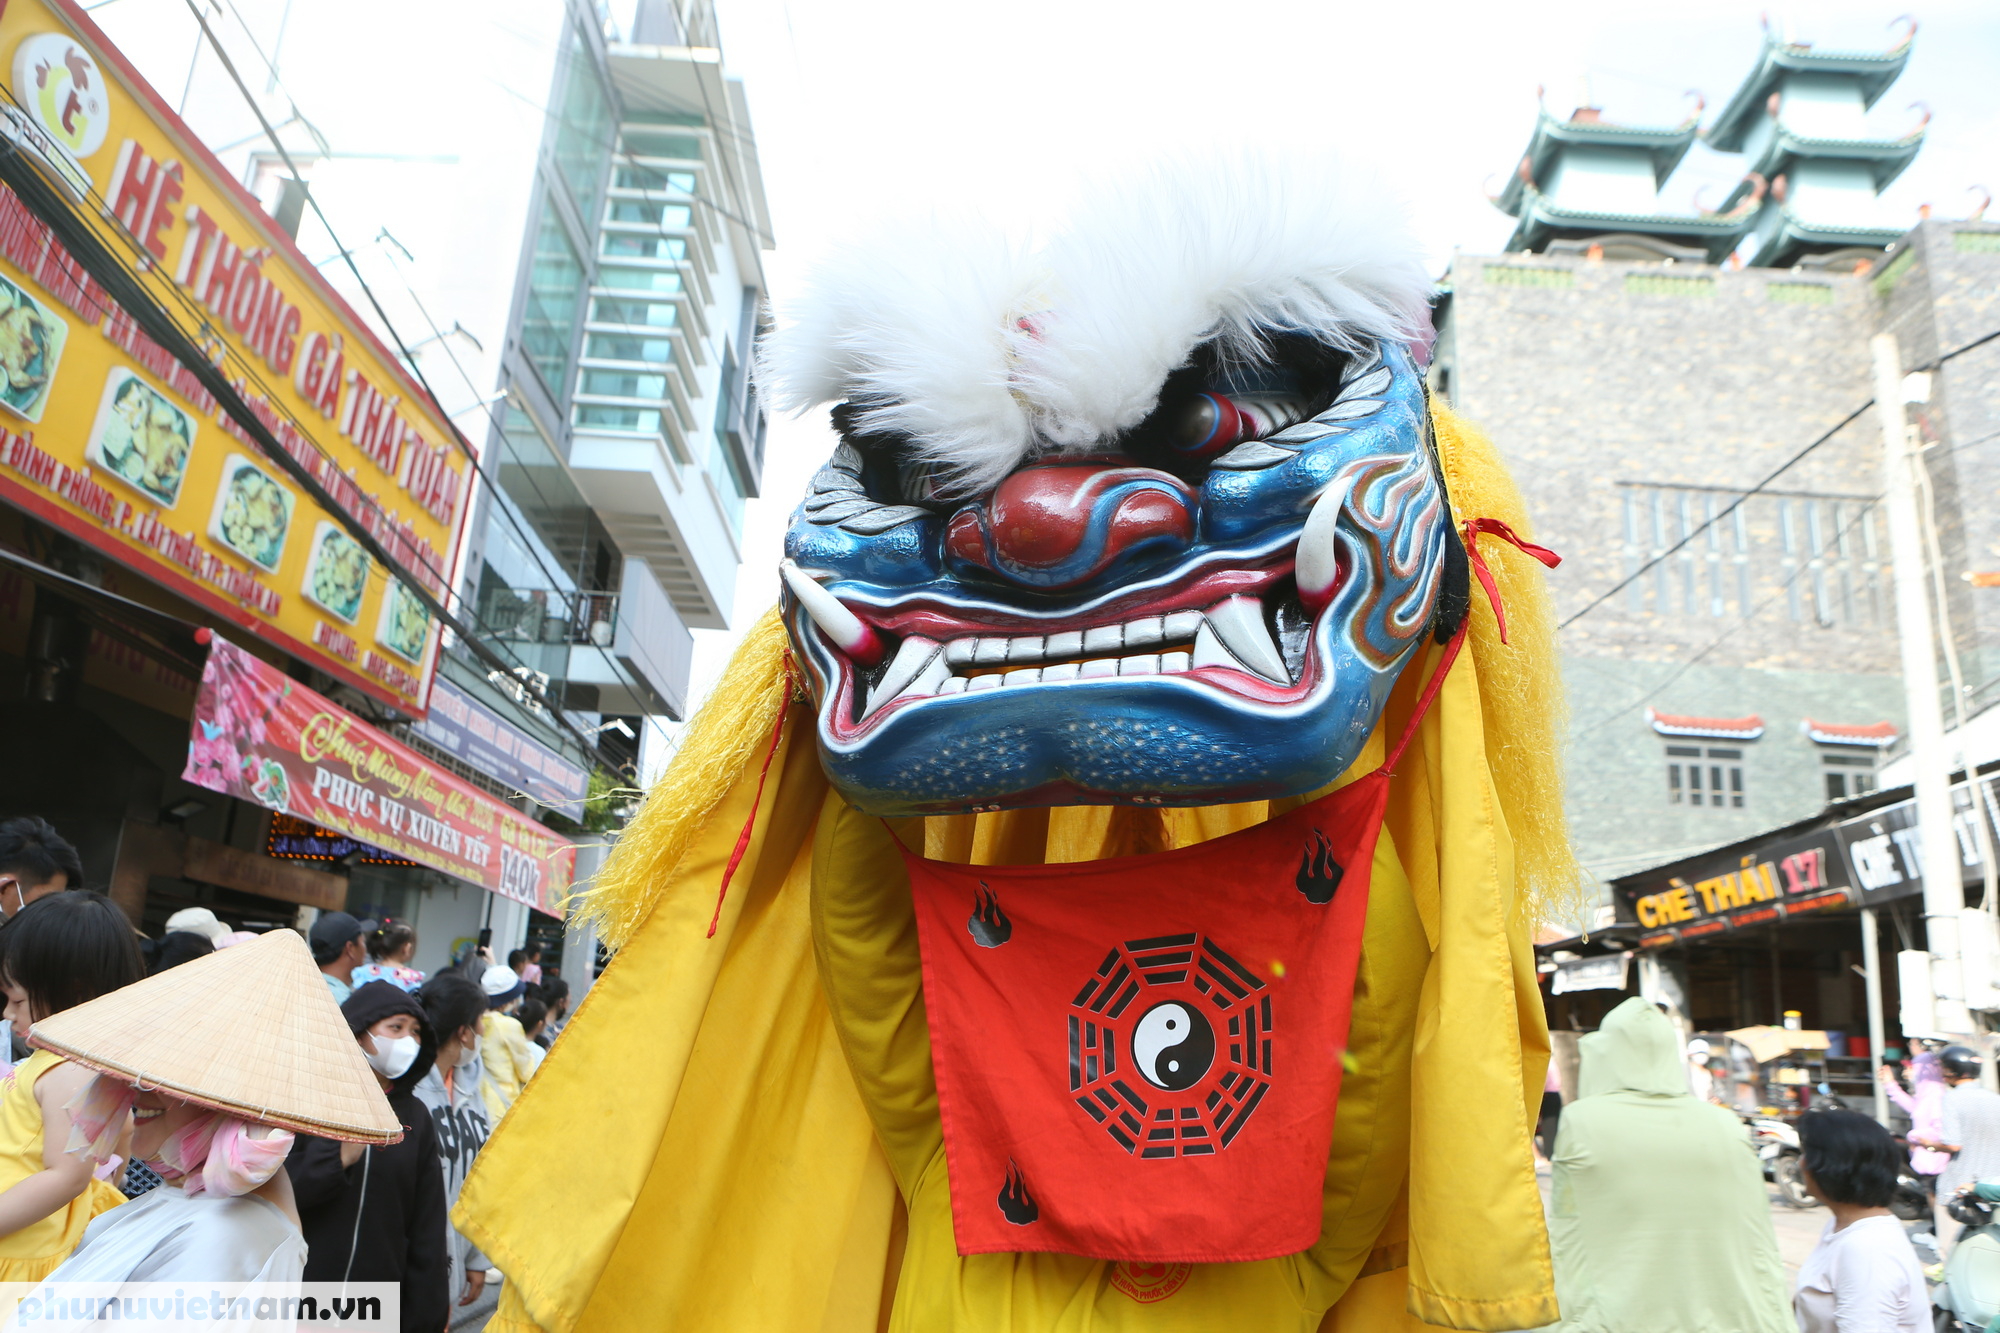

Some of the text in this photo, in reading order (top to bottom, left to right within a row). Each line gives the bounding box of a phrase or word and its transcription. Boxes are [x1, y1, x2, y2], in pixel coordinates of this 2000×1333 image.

[101, 138, 184, 272] HỆ
[175, 203, 302, 377] THỐNG
[295, 332, 344, 420] GÀ
[339, 368, 408, 476] THÁI
[398, 428, 461, 526] TUẤN
[300, 711, 371, 783] Chúc
[364, 745, 411, 798] Mừng
[407, 766, 445, 819] Năm
[311, 765, 375, 818] PHỤC
[379, 794, 406, 835] VỤ
[407, 808, 462, 856] XUYÊN
[464, 834, 491, 868] TẾT
[1850, 822, 1904, 891] CHÈ
[499, 844, 541, 907] 140k
[1636, 876, 1701, 929] CHÈ
[1693, 853, 1785, 914] THÁI
[1780, 846, 1828, 894] 17
